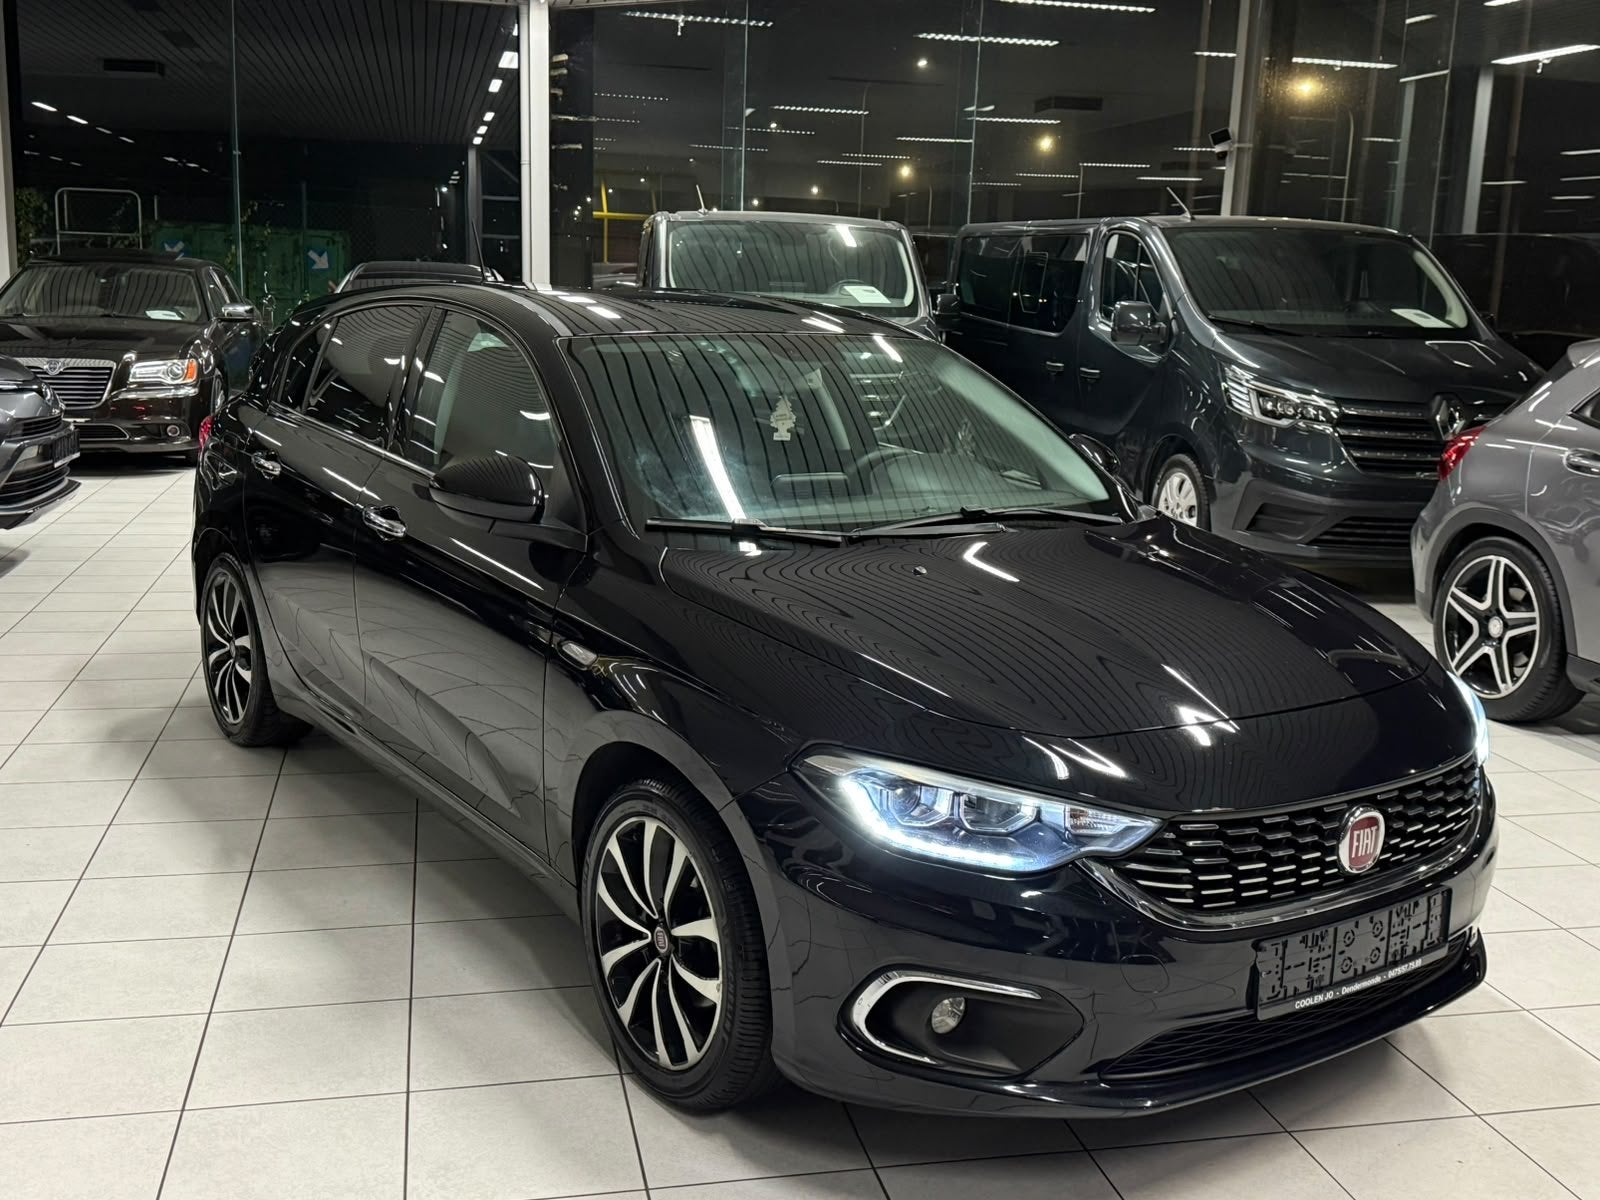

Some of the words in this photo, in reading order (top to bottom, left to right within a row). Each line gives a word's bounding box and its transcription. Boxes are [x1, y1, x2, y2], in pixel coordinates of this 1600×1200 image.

[1351, 825, 1378, 858] FIAT
[1294, 995, 1324, 1009] COOLEN
[1324, 991, 1334, 1001] JO
[1341, 975, 1382, 995] Dendermonde
